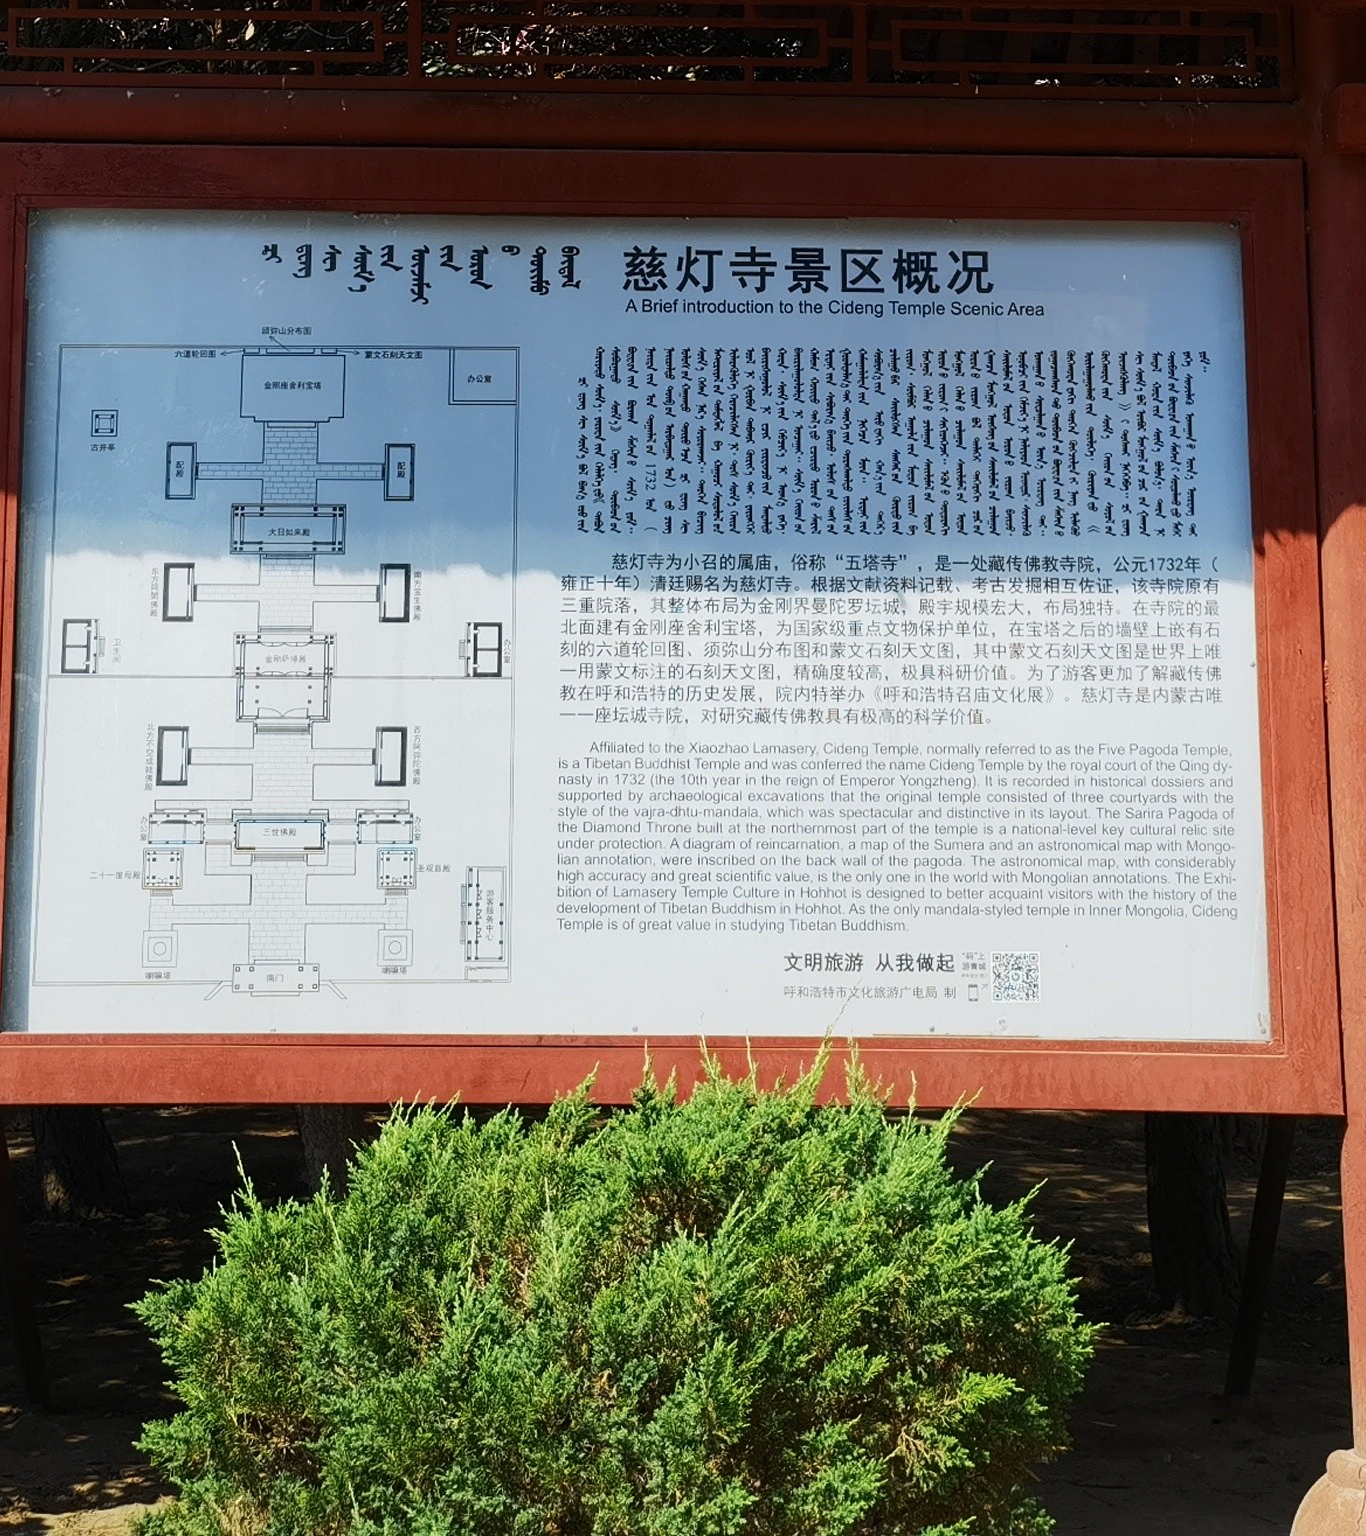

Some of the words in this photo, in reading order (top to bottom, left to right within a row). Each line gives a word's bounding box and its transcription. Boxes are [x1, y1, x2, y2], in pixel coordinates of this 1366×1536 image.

[622, 245, 994, 294] 慈灯寺景区概况
[624, 298, 637, 312] A
[641, 298, 678, 313] Brief
[682, 298, 773, 313] introduction
[778, 300, 793, 313] to
[798, 299, 822, 314] the
[828, 299, 883, 318] Cideng
[888, 300, 945, 318] Temple
[950, 300, 1004, 316] Scenic
[1006, 301, 1044, 316] Area
[467, 375, 492, 384] 办公室
[91, 444, 116, 452] 古井亭
[588, 740, 644, 753] Affiliated
[648, 742, 660, 753] to
[664, 741, 684, 753] the
[688, 741, 749, 753] Xiaozhao
[752, 742, 819, 757] Lamasery,
[822, 741, 868, 757] Cideng
[872, 742, 922, 757] Temple,
[926, 742, 981, 757] normally
[984, 742, 1035, 754] referred
[1039, 743, 1051, 754] to
[1055, 745, 1070, 755] as
[1074, 743, 1094, 755] the
[1098, 742, 1125, 755] Five
[1129, 742, 1178, 758] Pagoda
[1181, 743, 1231, 757] Temple,
[557, 869, 584, 884] high
[587, 871, 646, 884] accuracy
[650, 869, 674, 881] and
[678, 870, 711, 884] great
[715, 869, 771, 882] scientific
[774, 870, 813, 883] value,
[817, 870, 827, 882] is
[831, 870, 852, 882] the
[855, 870, 882, 885] only
[885, 873, 910, 882] one
[914, 870, 925, 882] in
[929, 870, 949, 883] the
[953, 870, 987, 883] world
[991, 871, 1017, 883] with
[1021, 870, 1088, 886] Mongolian
[1092, 871, 1170, 884] annotations.
[1175, 871, 1199, 884] The
[1203, 871, 1236, 884] Exhi-
[556, 917, 603, 932] Temple
[607, 918, 618, 930] is
[621, 917, 635, 930] of
[638, 918, 672, 933] great
[676, 918, 710, 930] value
[715, 918, 726, 930] in
[730, 918, 784, 934] studying
[788, 918, 836, 931] Tibetan
[841, 918, 908, 931] Buddhism.
[783, 952, 864, 972] 文明旅游
[875, 952, 955, 972] 从我做起
[784, 986, 937, 1000] 呼和浩特市文化旅游广电局
[944, 986, 957, 1000] 制
